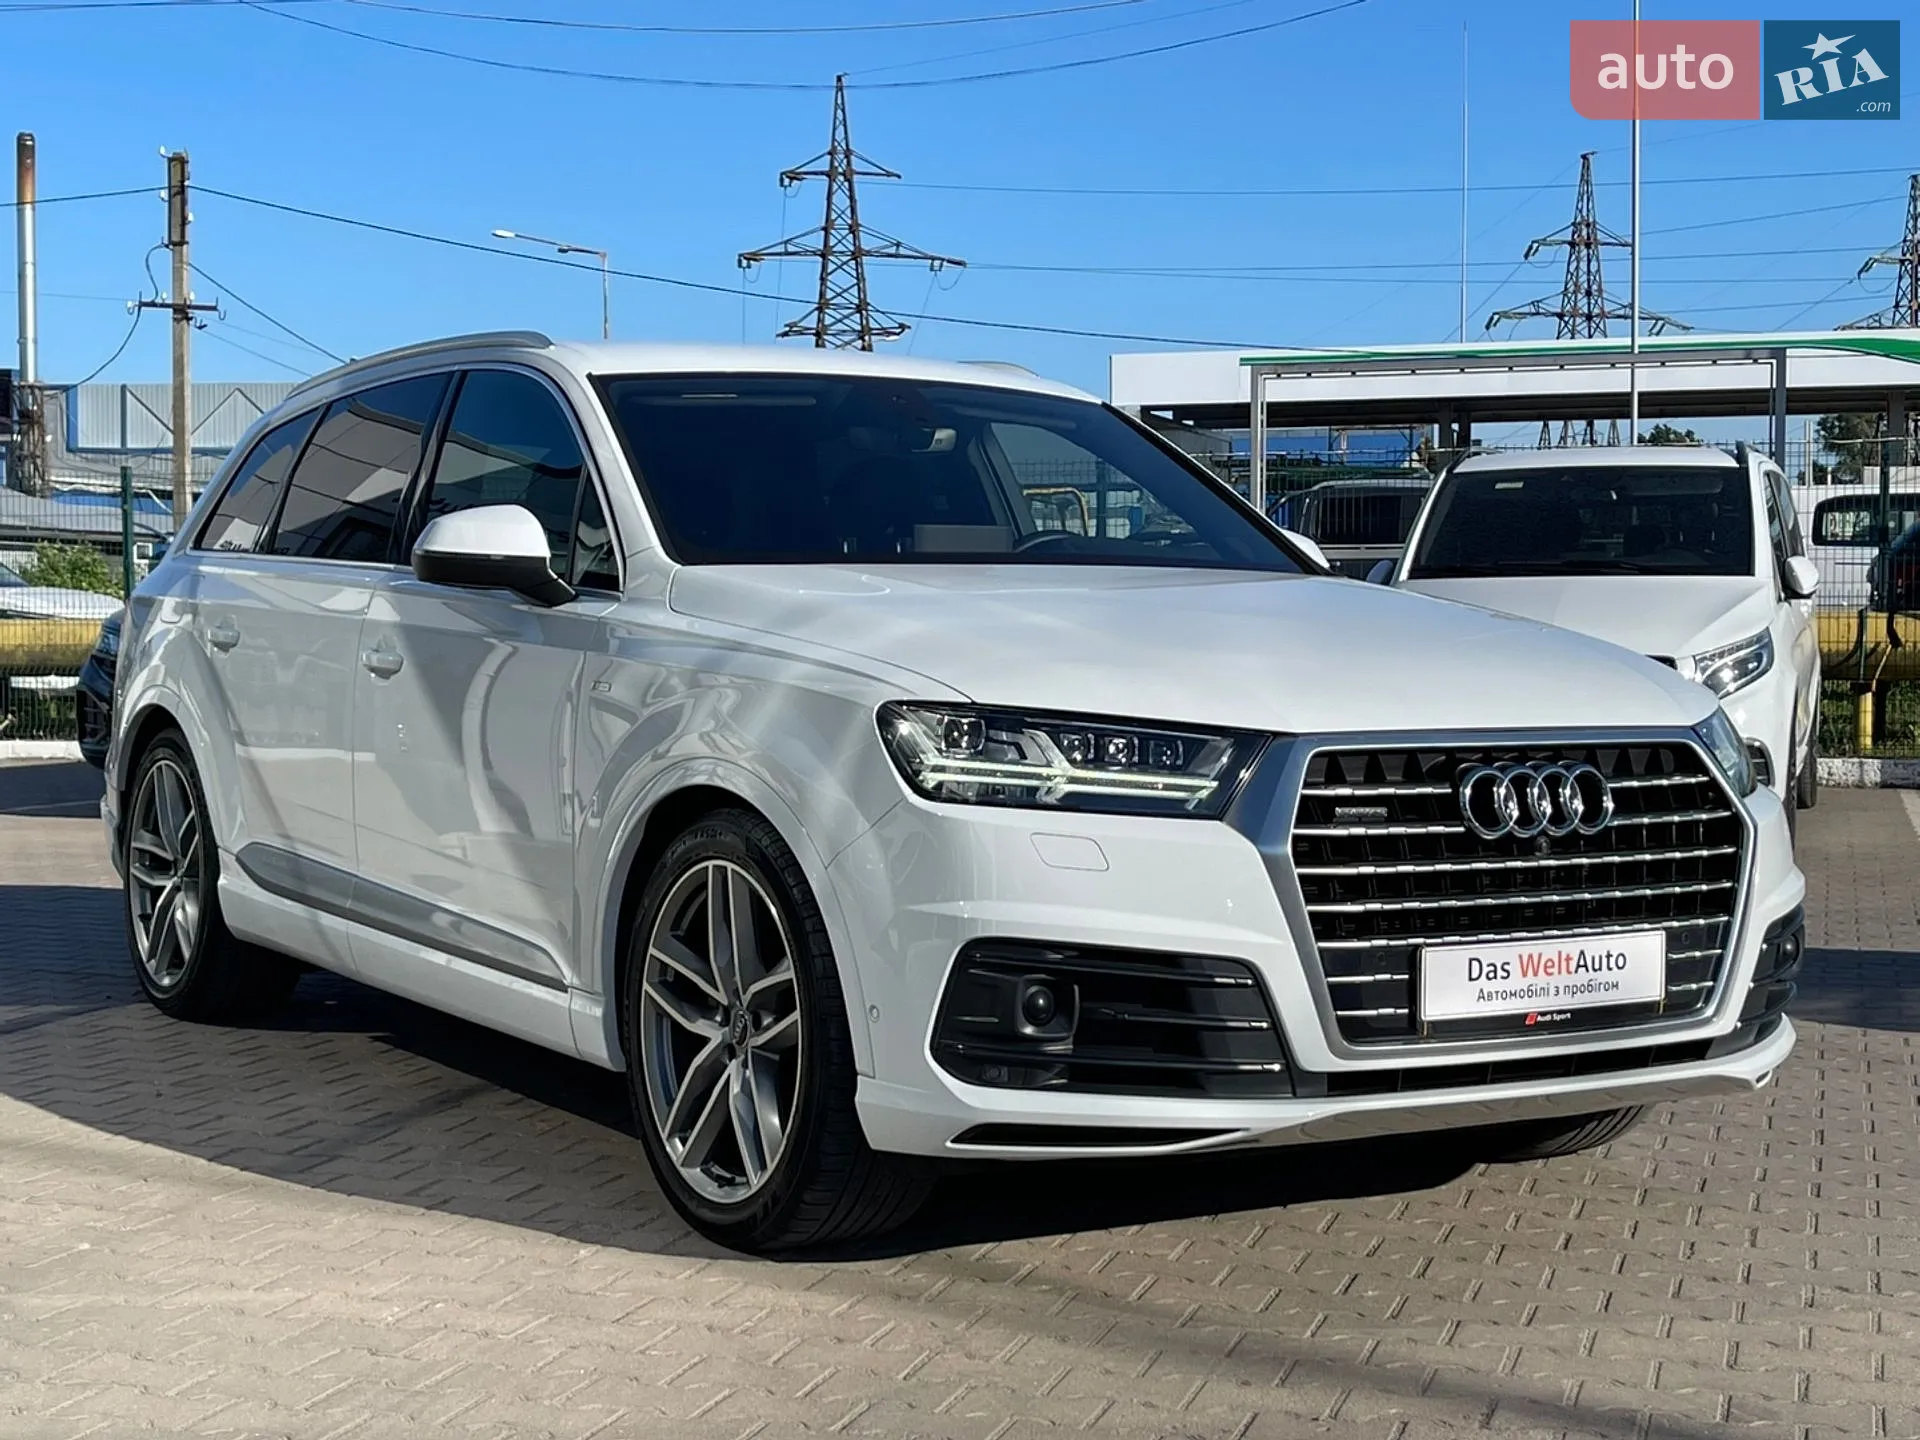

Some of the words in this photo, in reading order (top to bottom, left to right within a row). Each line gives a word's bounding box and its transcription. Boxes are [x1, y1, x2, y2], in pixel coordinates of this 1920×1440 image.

[1467, 957, 1512, 982] Das
[1518, 949, 1628, 978] WeltAuto
[1476, 982, 1551, 1003] Автомобілі
[1563, 979, 1620, 999] пробігом
